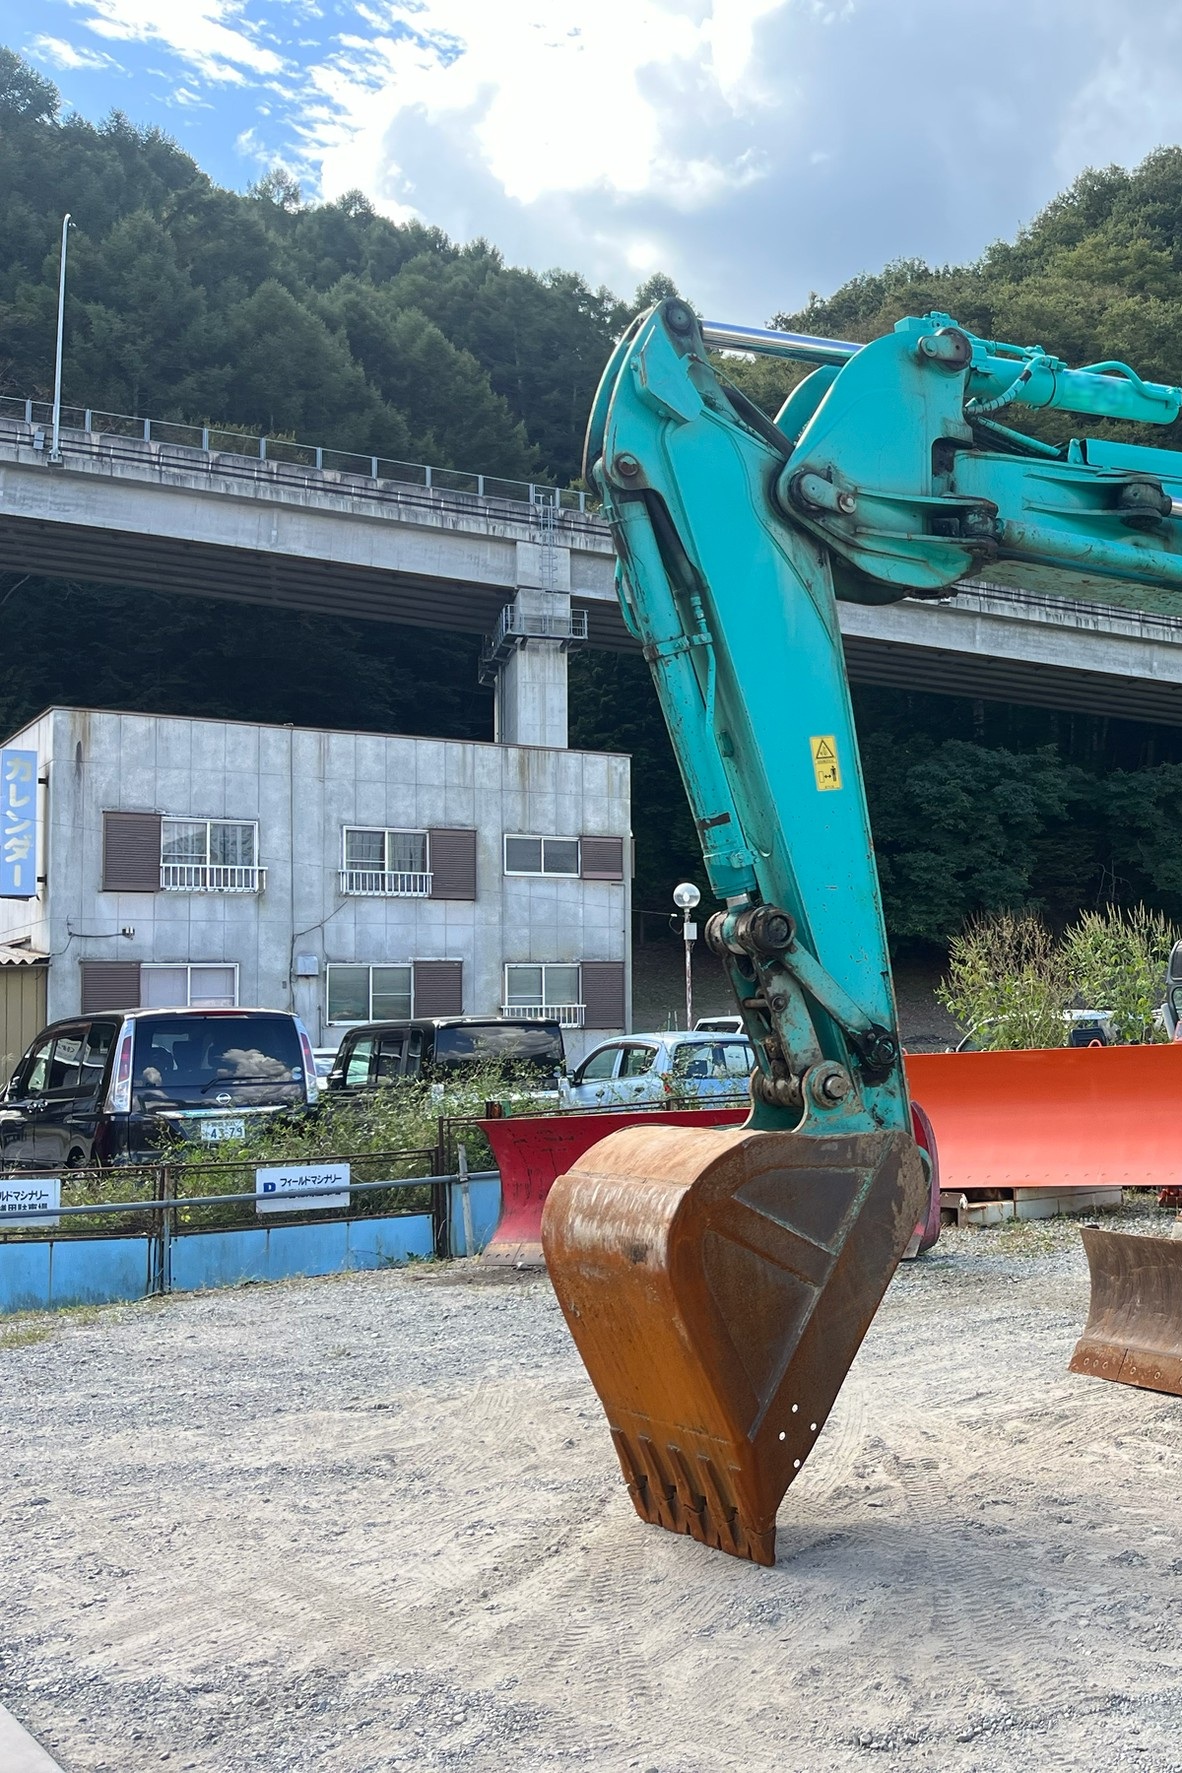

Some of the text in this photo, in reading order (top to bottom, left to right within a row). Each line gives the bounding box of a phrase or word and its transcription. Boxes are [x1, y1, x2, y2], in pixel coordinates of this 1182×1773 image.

[4, 757, 32, 888] カレンダー
[279, 1173, 342, 1187] フィールドマシナリー
